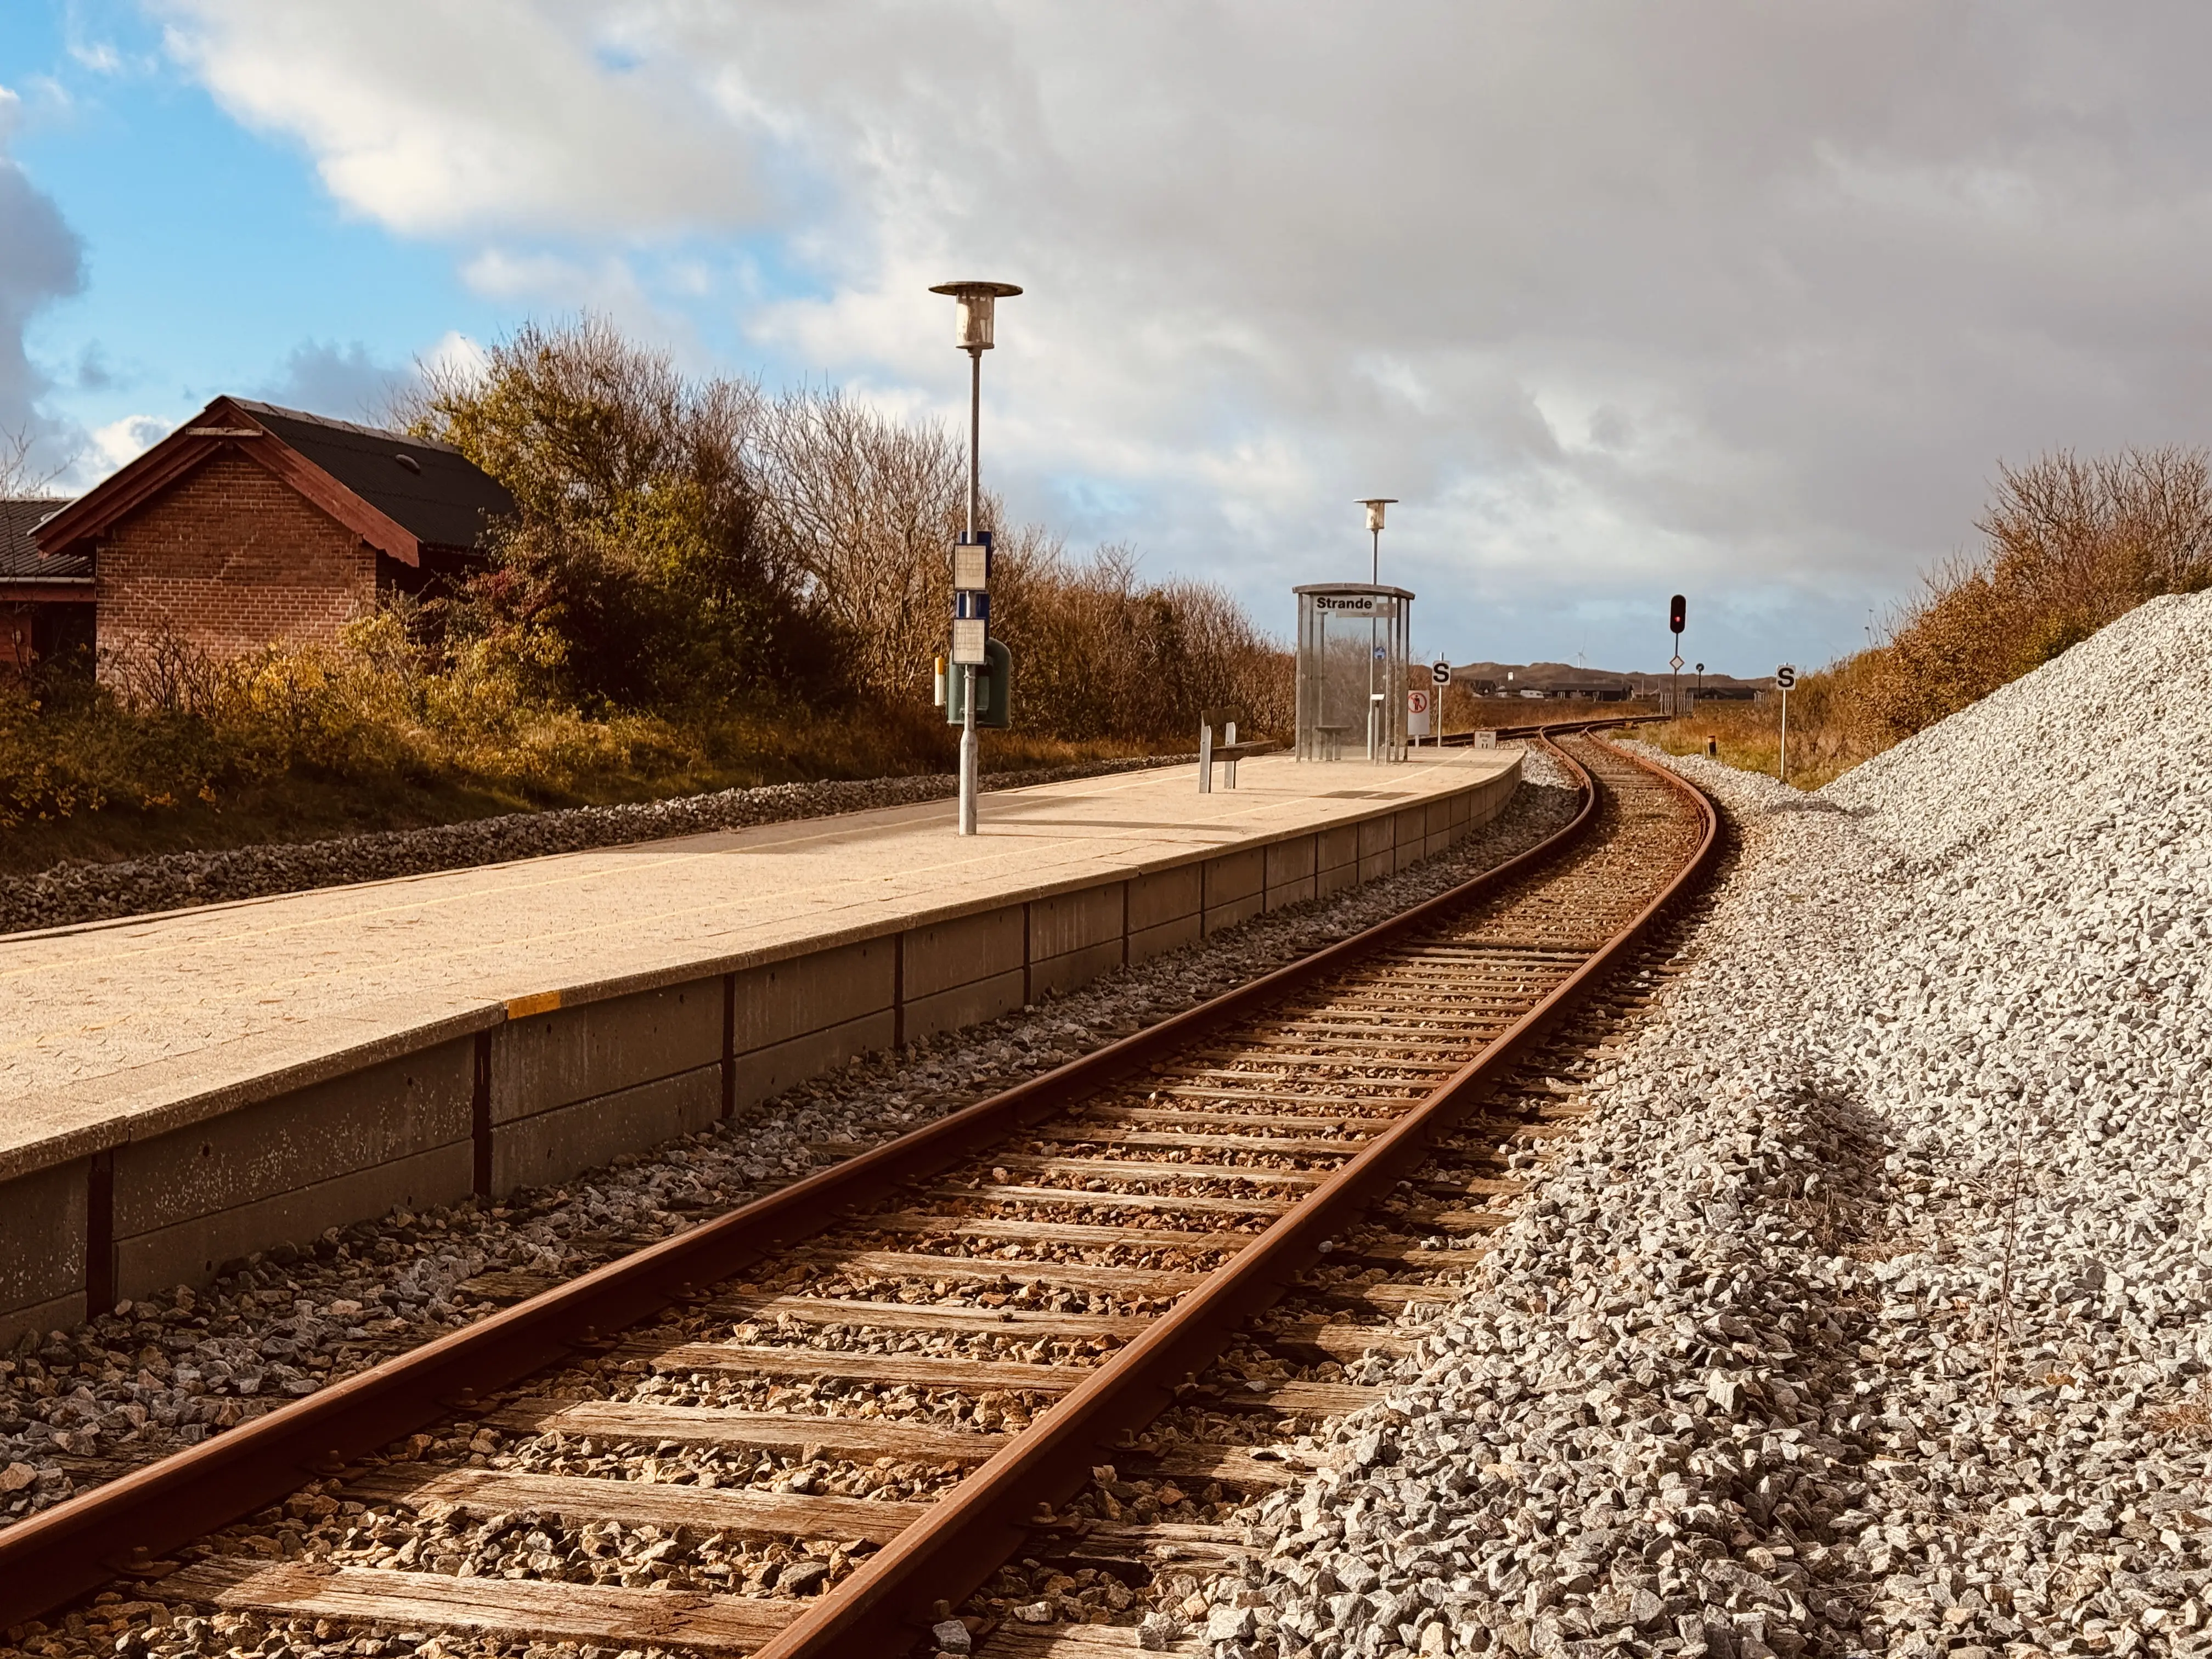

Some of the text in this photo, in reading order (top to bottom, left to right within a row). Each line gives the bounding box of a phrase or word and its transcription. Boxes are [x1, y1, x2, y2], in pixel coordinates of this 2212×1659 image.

[1317, 597, 1372, 609] Strande
[1433, 663, 1449, 682] S
[1778, 667, 1794, 687] S
